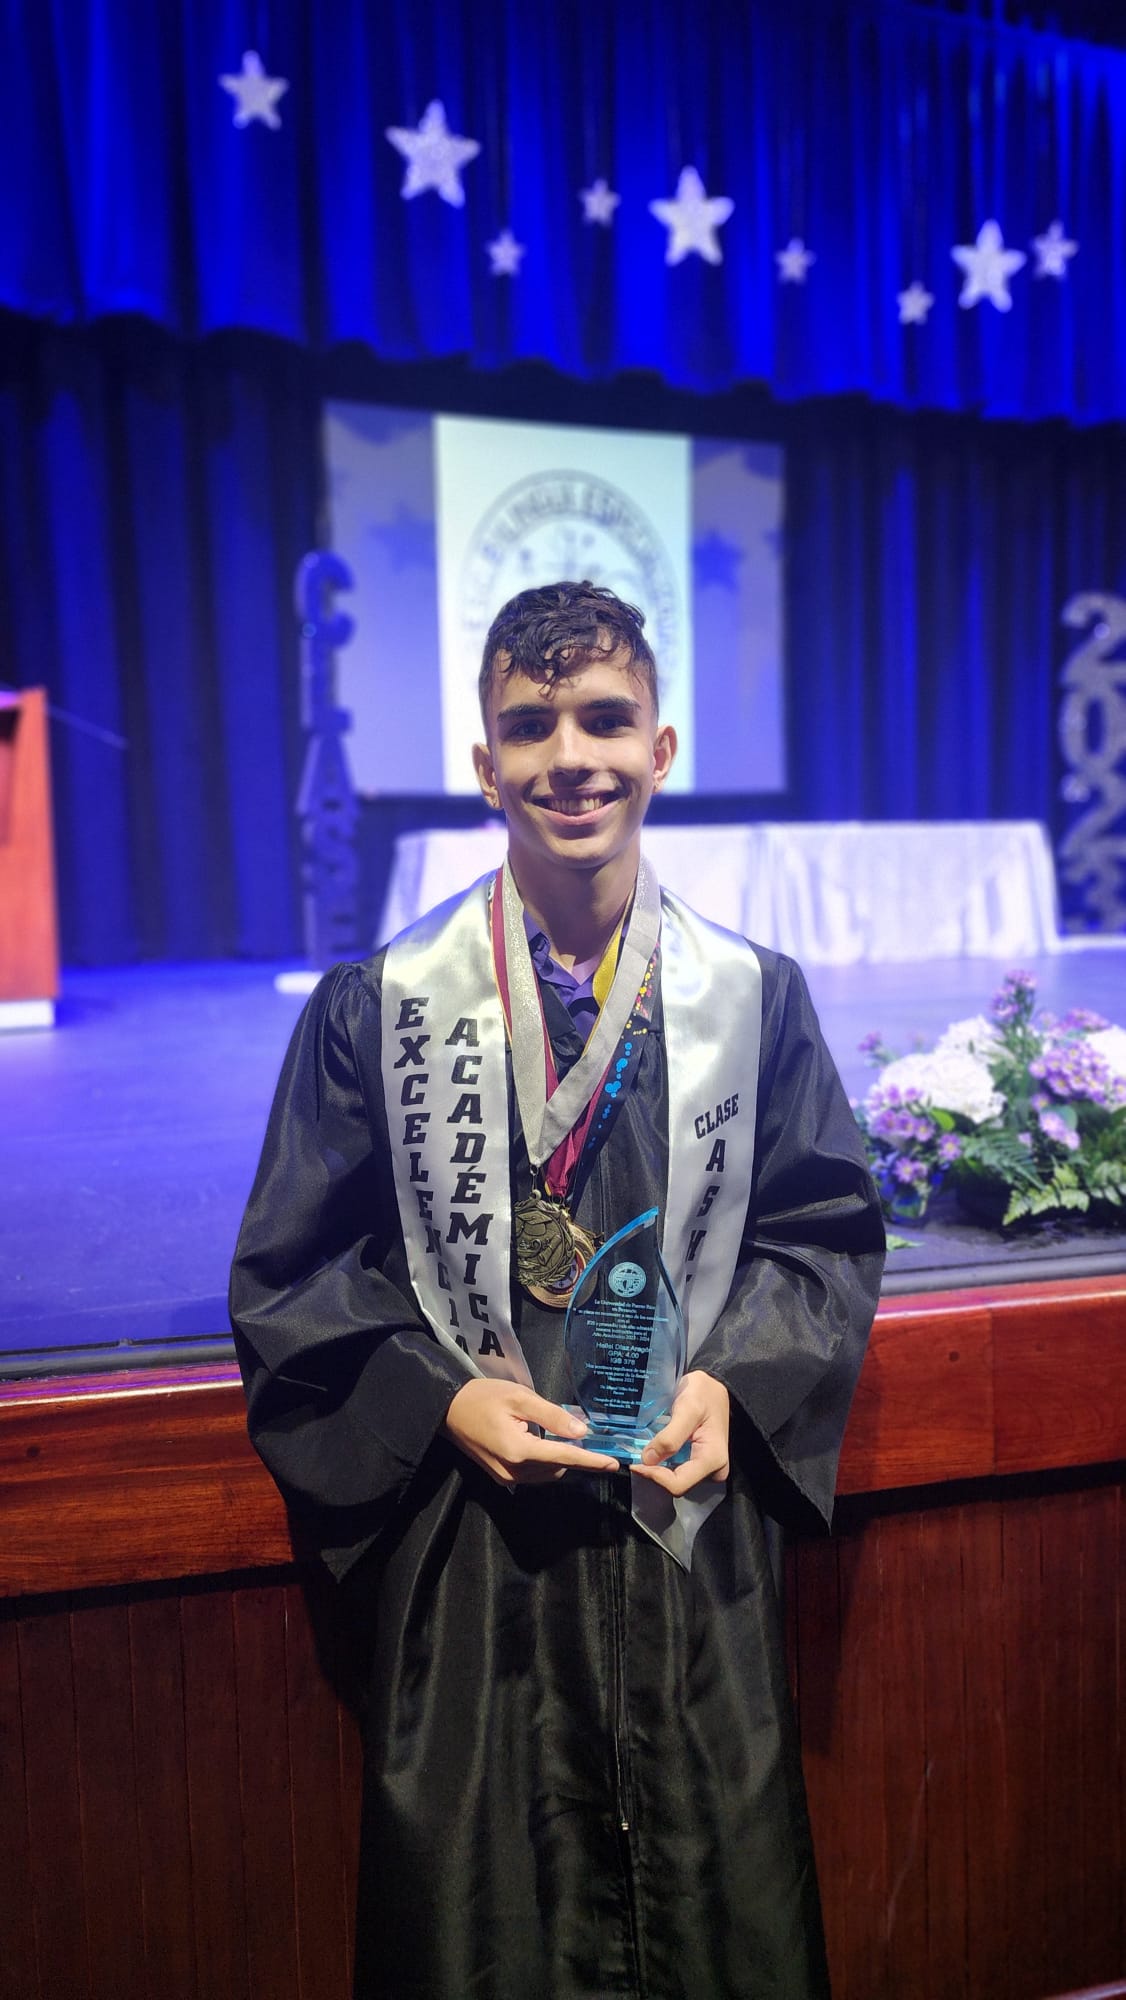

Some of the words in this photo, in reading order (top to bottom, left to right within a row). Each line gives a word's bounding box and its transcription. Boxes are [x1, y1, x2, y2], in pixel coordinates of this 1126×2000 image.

[394, 996, 469, 1356] EXCELENCIA
[445, 1017, 505, 1358] ACADÉMICA
[694, 1093, 739, 1140] CLASE
